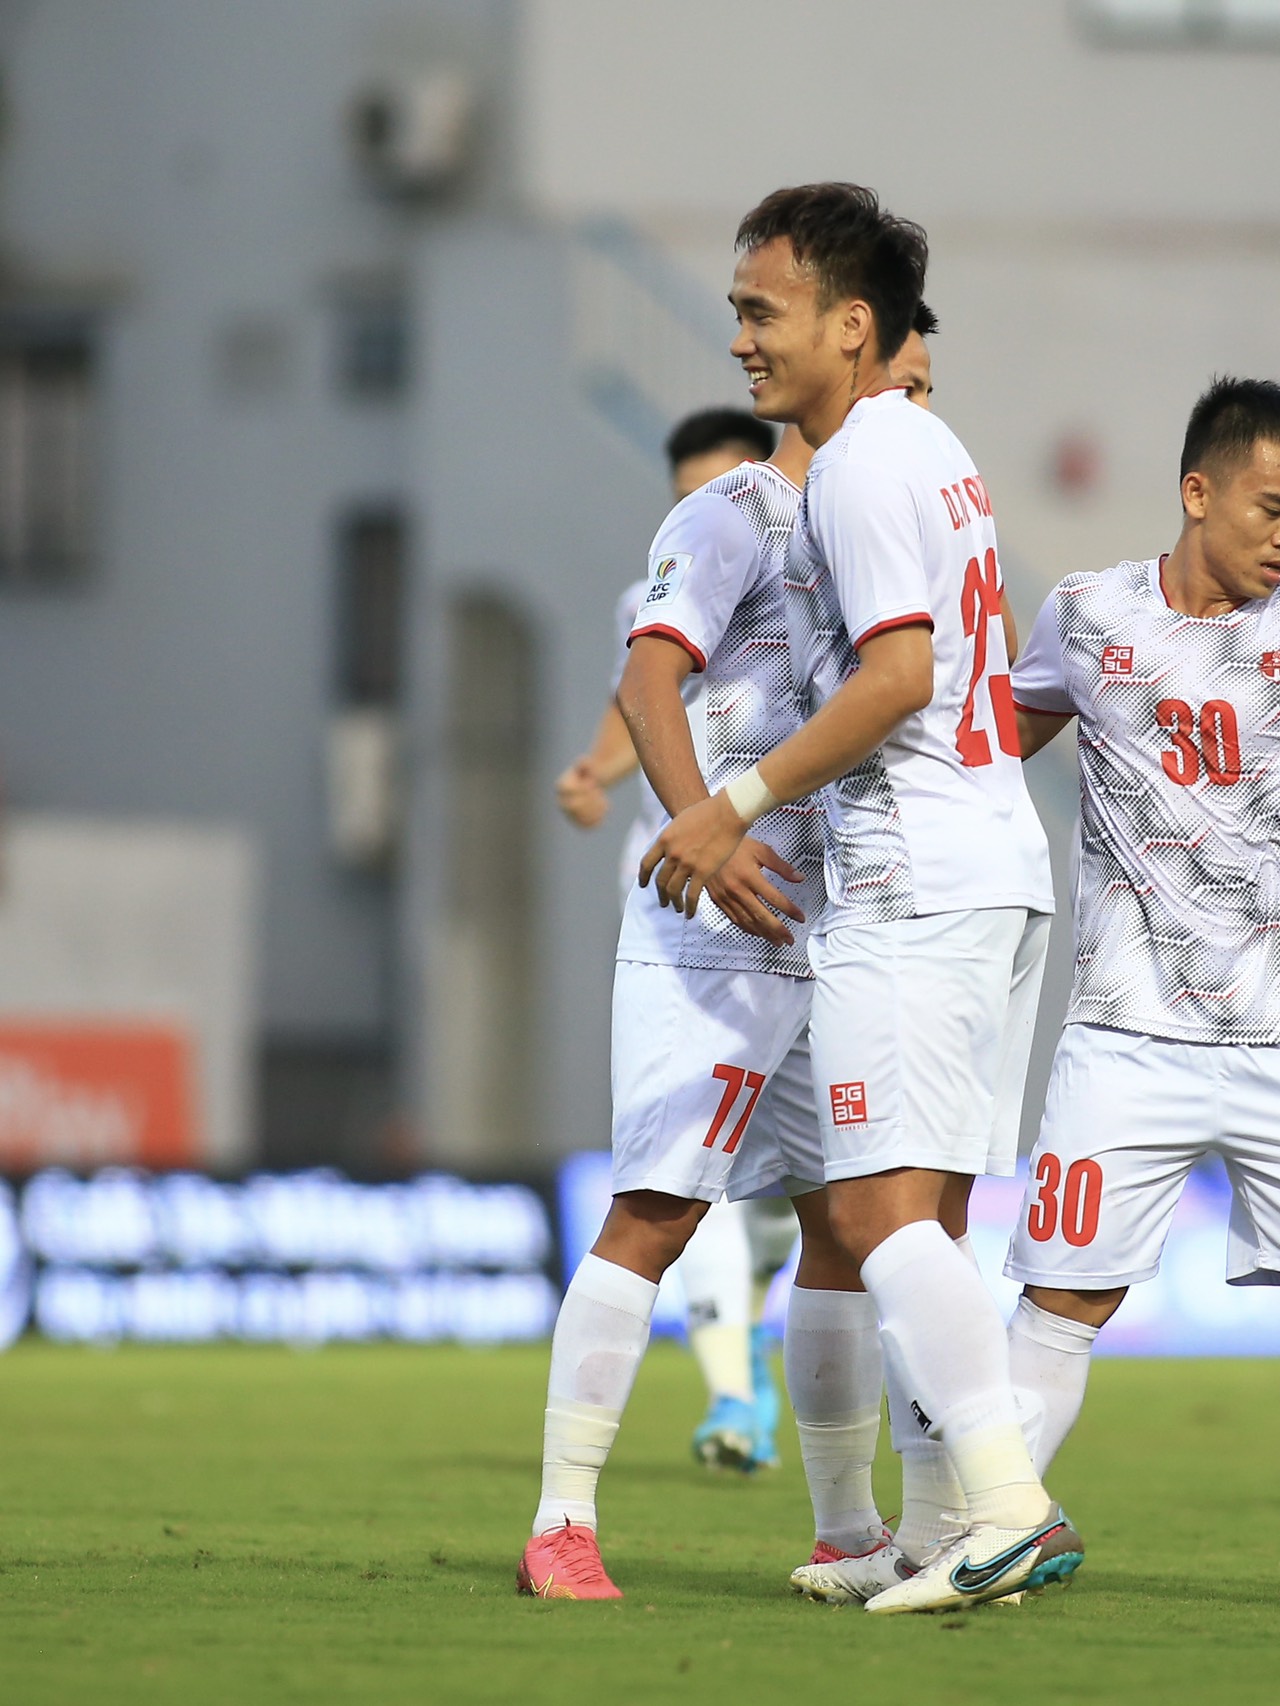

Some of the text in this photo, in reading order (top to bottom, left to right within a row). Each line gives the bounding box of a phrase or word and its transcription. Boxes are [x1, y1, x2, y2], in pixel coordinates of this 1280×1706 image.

[646, 592, 669, 603] CUP
[649, 582, 671, 594] AFC
[1155, 698, 1241, 787] 30
[833, 1085, 863, 1105] JG
[702, 1063, 768, 1154] 77
[834, 1104, 865, 1122] BL
[1027, 1152, 1103, 1247] 30
